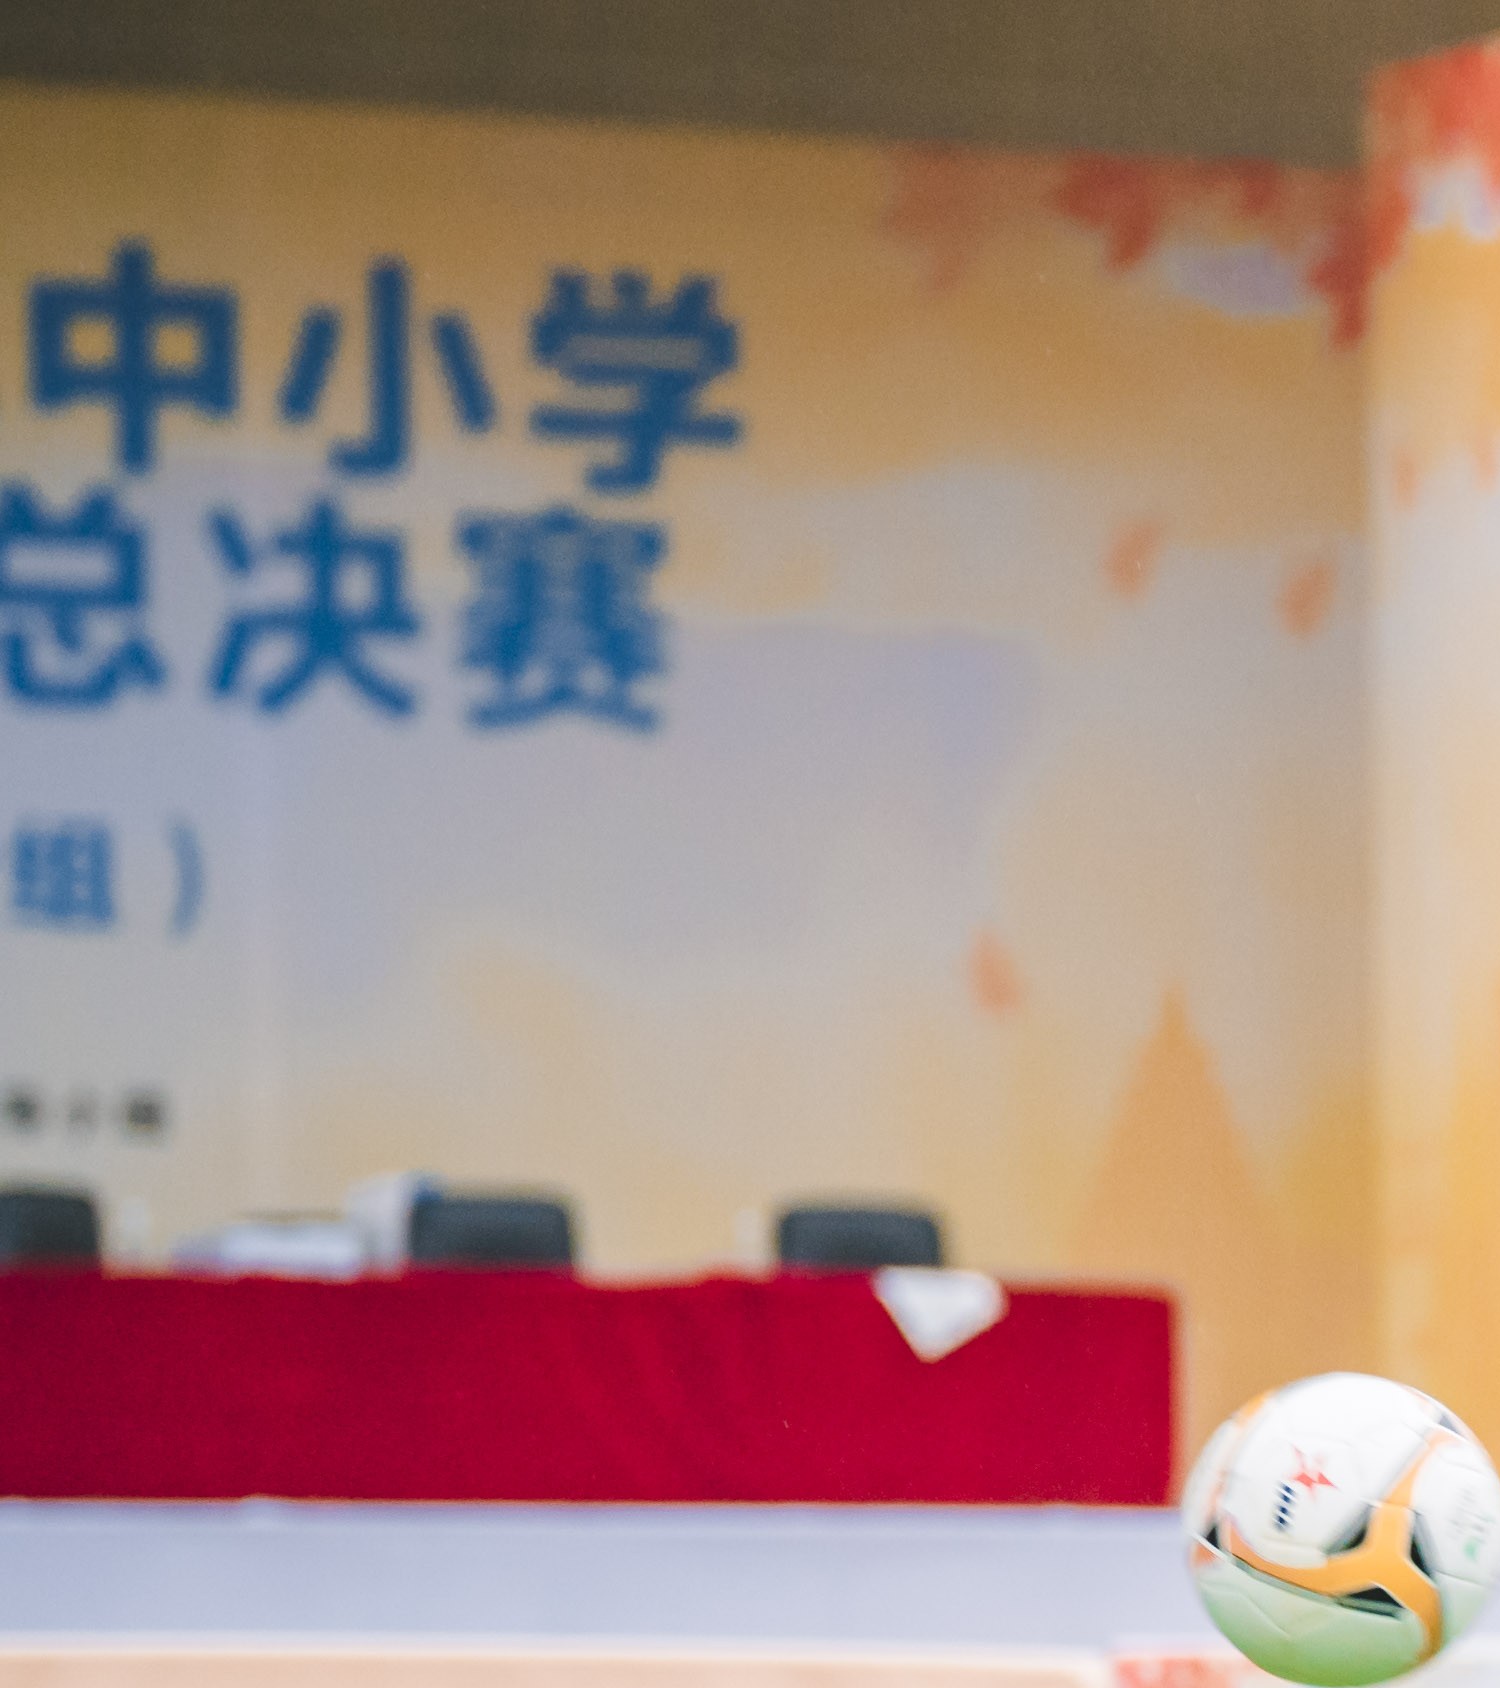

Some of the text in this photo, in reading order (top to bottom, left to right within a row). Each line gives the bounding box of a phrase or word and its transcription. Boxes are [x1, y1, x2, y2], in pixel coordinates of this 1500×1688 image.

[22, 238, 745, 492] 中小学
[0, 482, 675, 735] 总决赛
